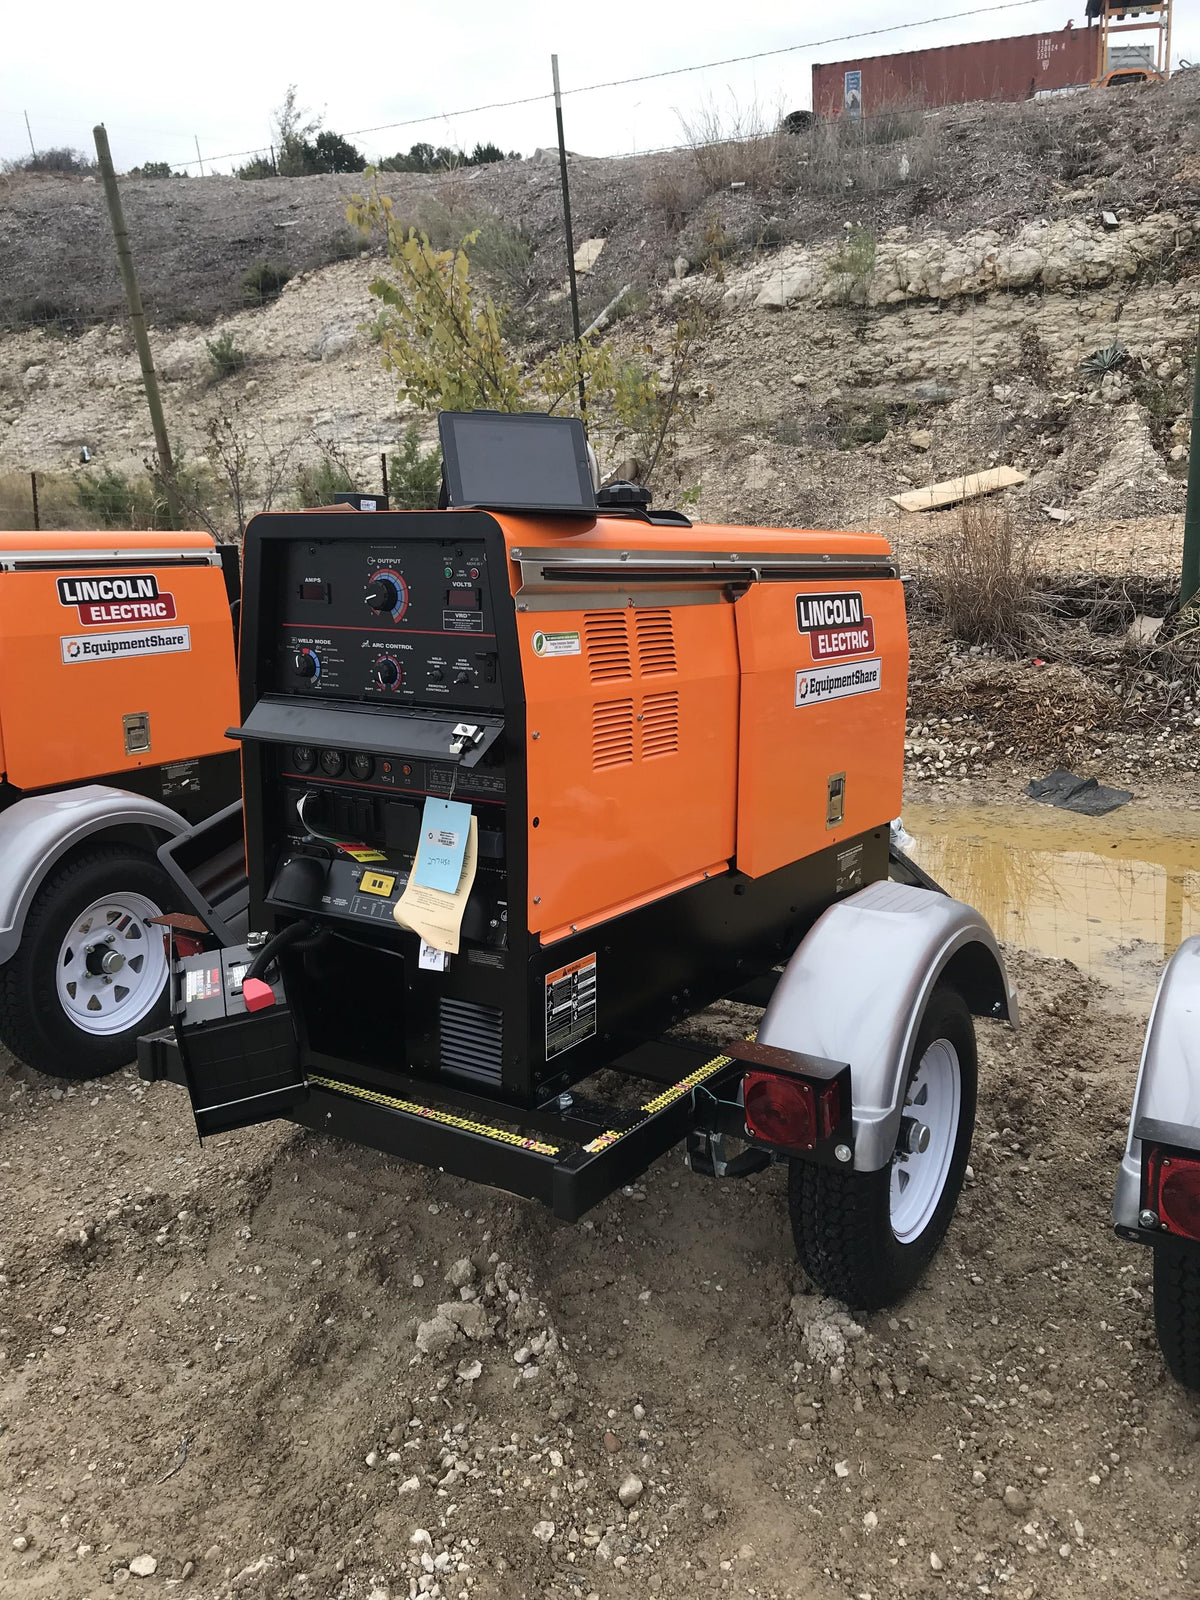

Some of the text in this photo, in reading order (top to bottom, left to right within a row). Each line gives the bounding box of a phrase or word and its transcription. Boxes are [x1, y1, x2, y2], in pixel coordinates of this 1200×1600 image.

[63, 579, 154, 602] LINCOLN
[90, 603, 167, 621] ELECTRIC
[800, 598, 861, 627] LINCOLN
[818, 630, 869, 654] ELECTRIC
[404, 1104, 419, 1112] ICI
[464, 1122, 494, 1134] PARE
[494, 1132, 523, 1143] AQUI
